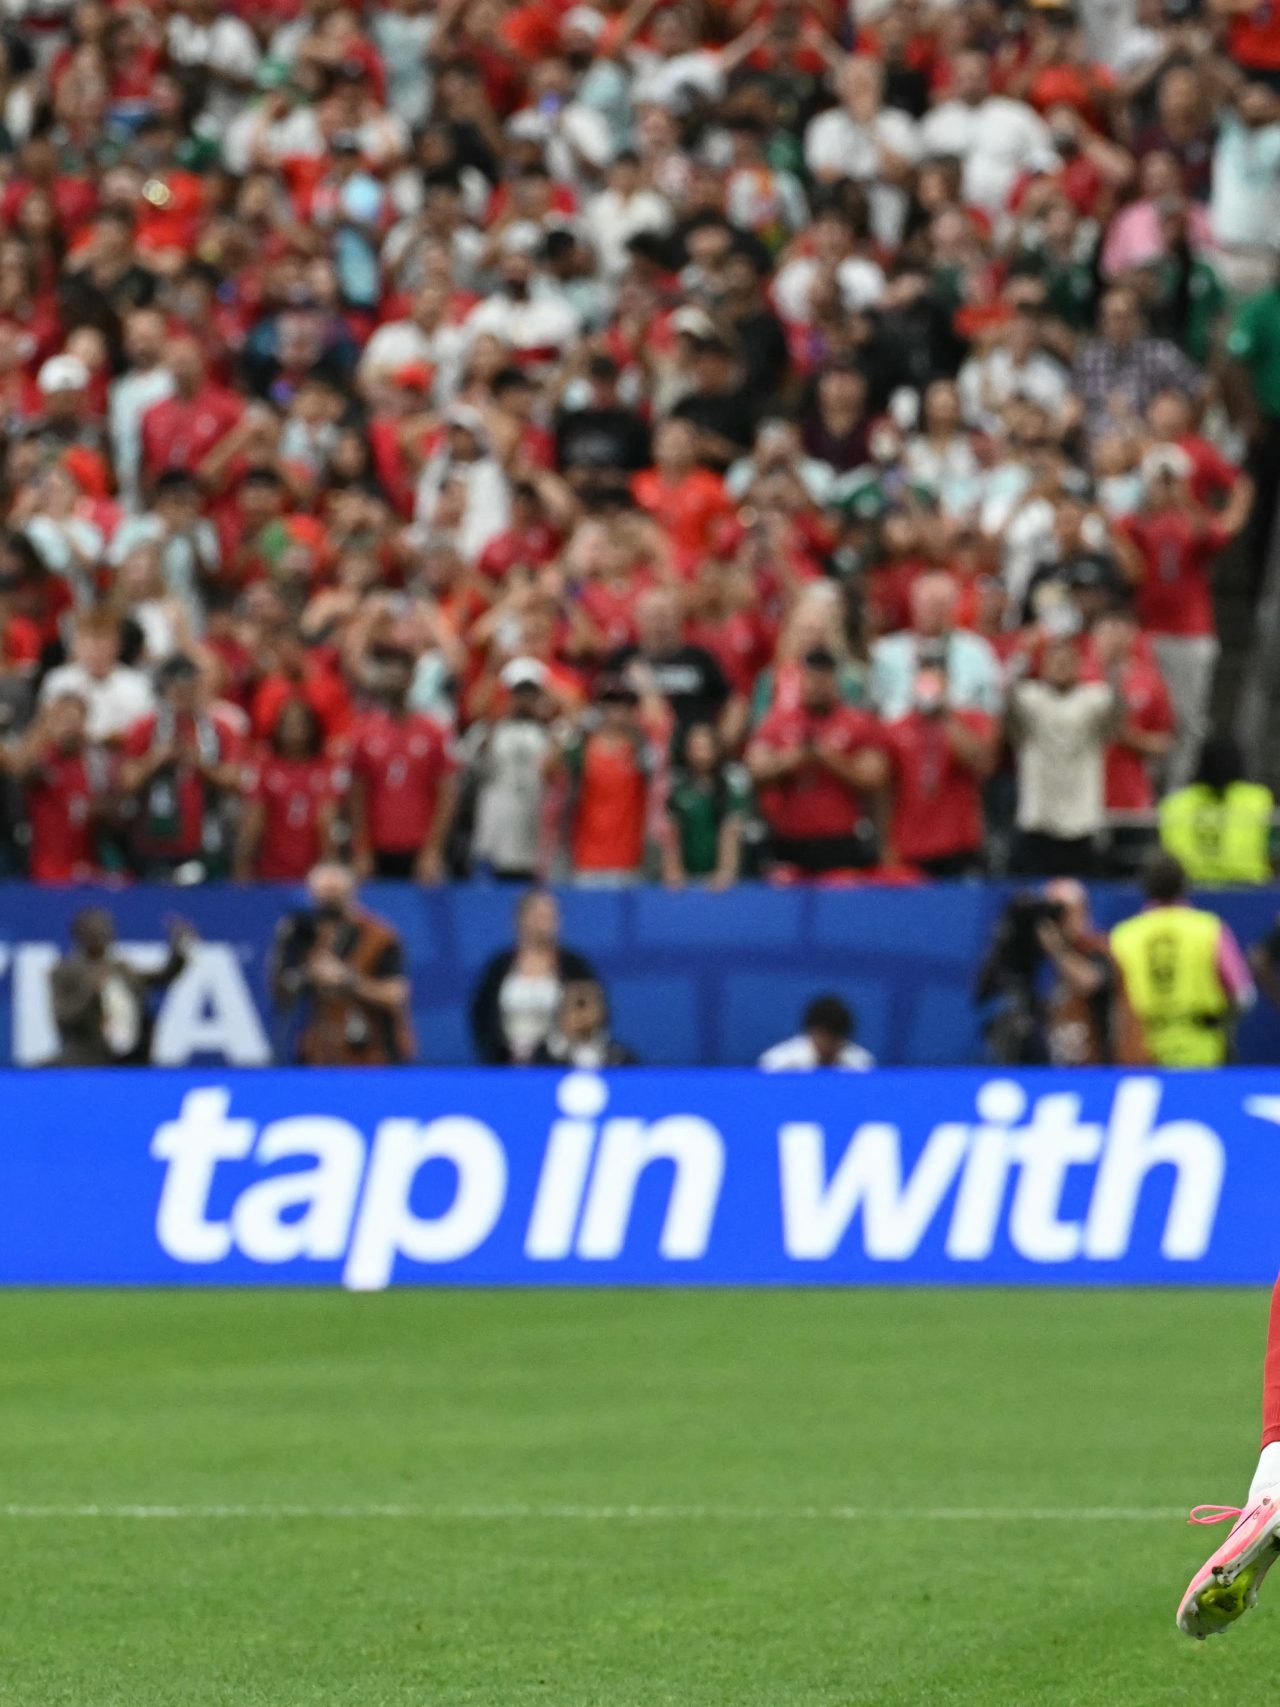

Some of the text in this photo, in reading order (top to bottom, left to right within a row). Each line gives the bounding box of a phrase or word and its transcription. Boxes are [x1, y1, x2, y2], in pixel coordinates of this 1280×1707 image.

[150, 1086, 508, 1291] tap
[524, 1072, 725, 1260] in
[778, 1075, 1226, 1262] with
